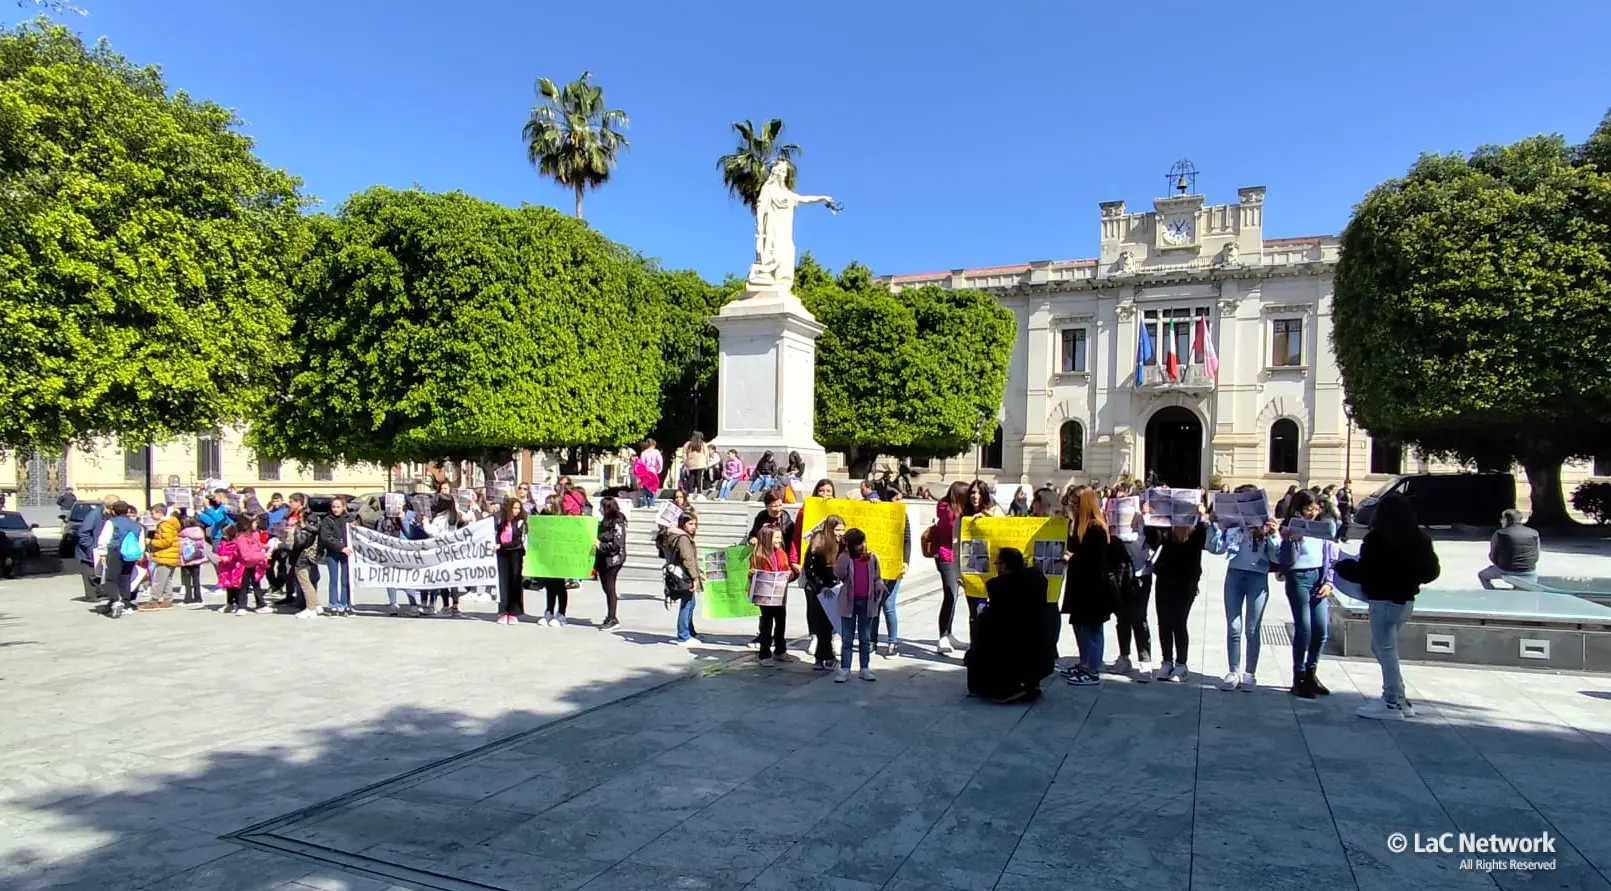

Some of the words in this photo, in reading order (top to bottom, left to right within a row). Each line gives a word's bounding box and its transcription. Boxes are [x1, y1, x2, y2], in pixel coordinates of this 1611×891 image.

[435, 527, 473, 546] ALLA
[435, 540, 495, 563] PRECLUDE
[354, 567, 365, 582] IL
[368, 567, 420, 583] DIRITTO
[423, 569, 450, 584] ALLO
[454, 565, 497, 582] STUDIO
